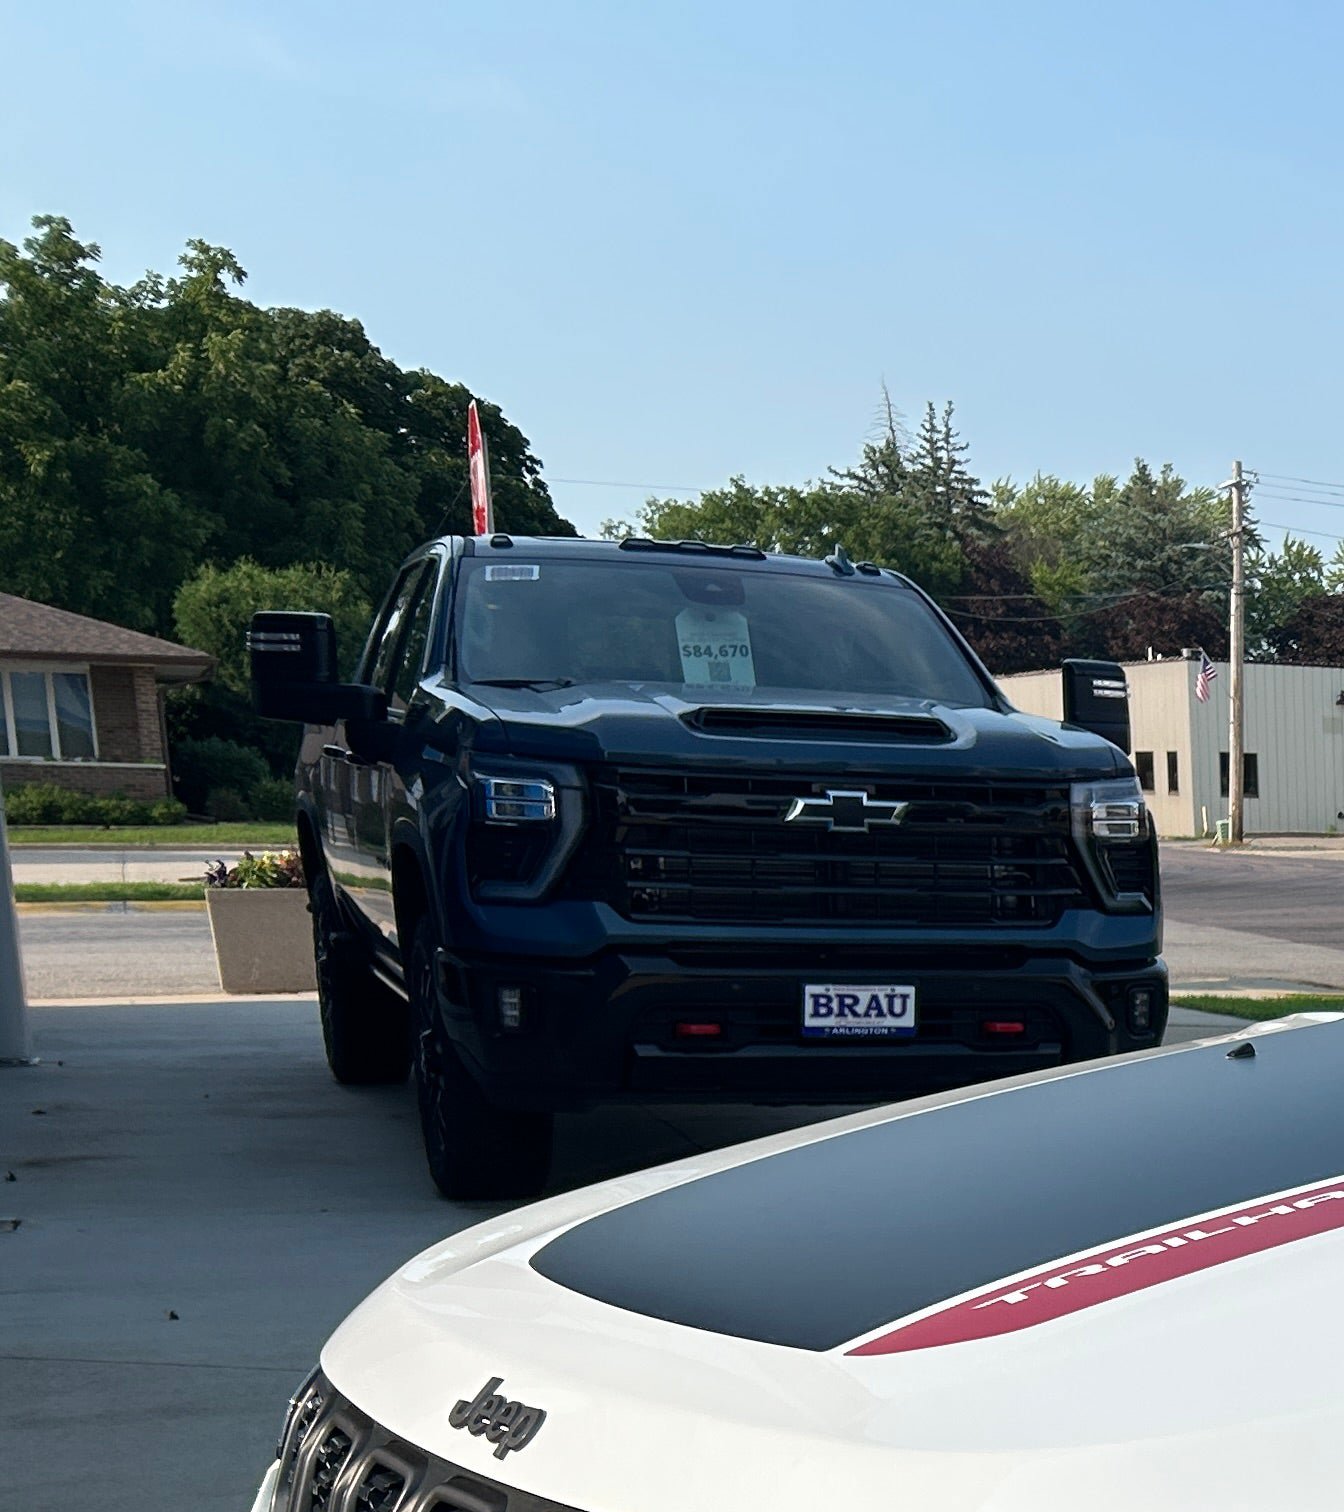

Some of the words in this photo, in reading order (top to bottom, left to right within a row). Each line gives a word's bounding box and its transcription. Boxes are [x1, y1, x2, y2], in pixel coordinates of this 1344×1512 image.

[682, 644, 749, 660] $84,670
[809, 993, 910, 1019] BRAU
[832, 1027, 888, 1035] ARLINGTON
[448, 1376, 548, 1461] Jeep
